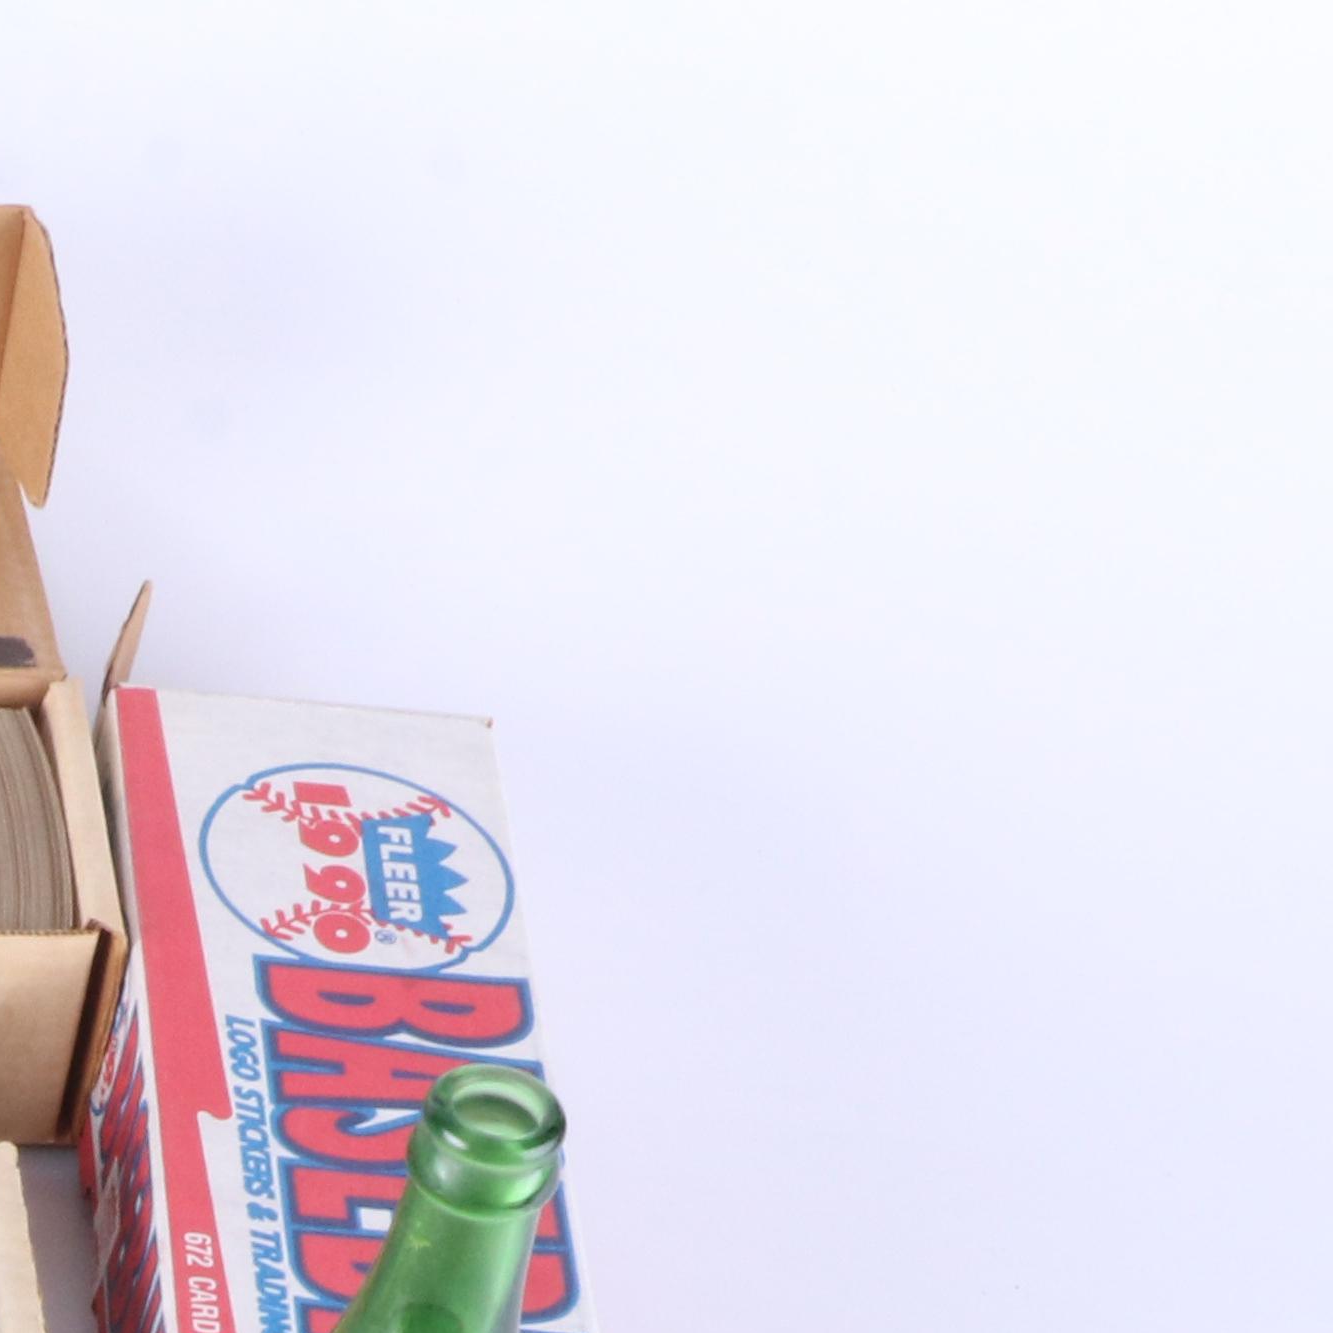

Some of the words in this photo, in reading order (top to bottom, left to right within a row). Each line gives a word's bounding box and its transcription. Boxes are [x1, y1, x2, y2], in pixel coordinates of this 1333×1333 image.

[293, 782, 371, 954] 1990
[377, 824, 423, 924] FLEER
[225, 1014, 261, 1082] LOGO
[184, 1231, 214, 1268] 672
